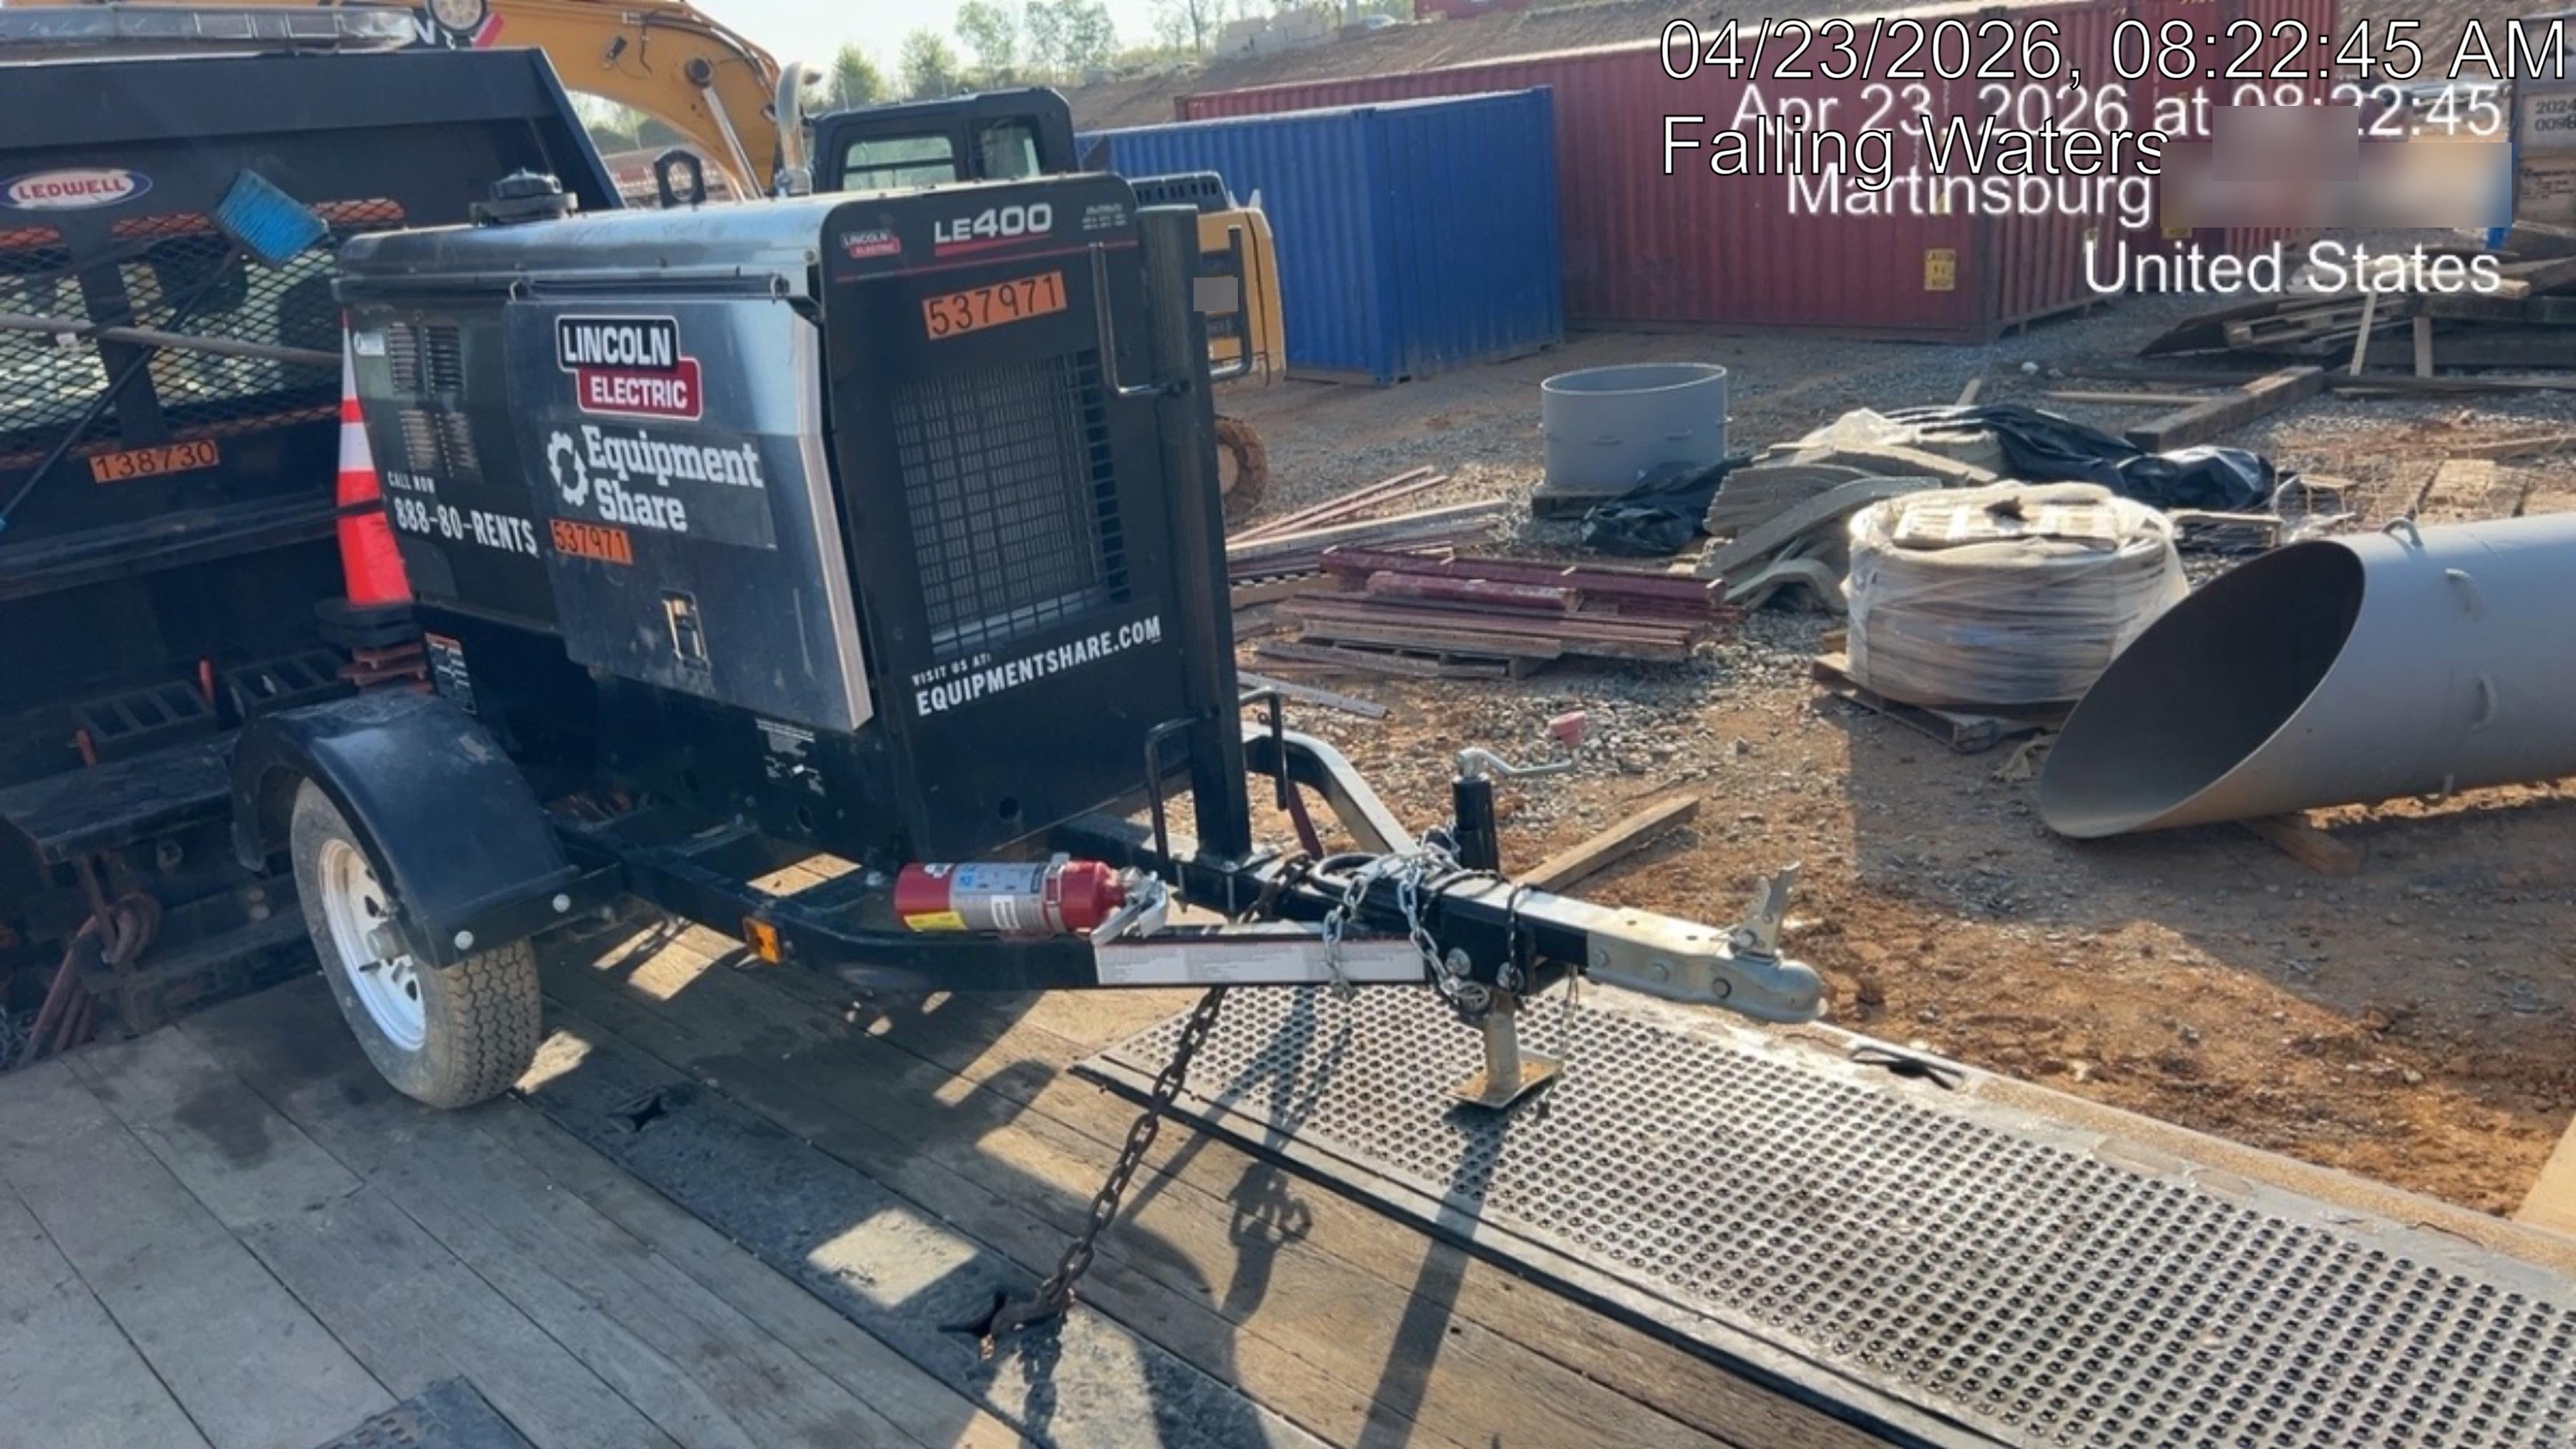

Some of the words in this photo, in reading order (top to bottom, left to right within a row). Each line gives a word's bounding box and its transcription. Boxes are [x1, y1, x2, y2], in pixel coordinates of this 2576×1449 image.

[18, 178, 125, 199] LEDWELL
[935, 203, 1052, 243] LE400
[929, 275, 1057, 336] 537971
[562, 326, 673, 366] LINCOLN
[590, 376, 688, 409] ELECTRIC
[95, 441, 215, 479] 138730
[581, 424, 764, 488] Equipment
[387, 471, 412, 490] CALL
[594, 477, 688, 532] Share
[394, 497, 539, 556] 888-80-RENTS
[553, 521, 628, 561] 537971
[912, 666, 947, 686] VISIT
[951, 661, 968, 675] US
[915, 615, 1162, 716] EQUIPMENTSHARE.COM
